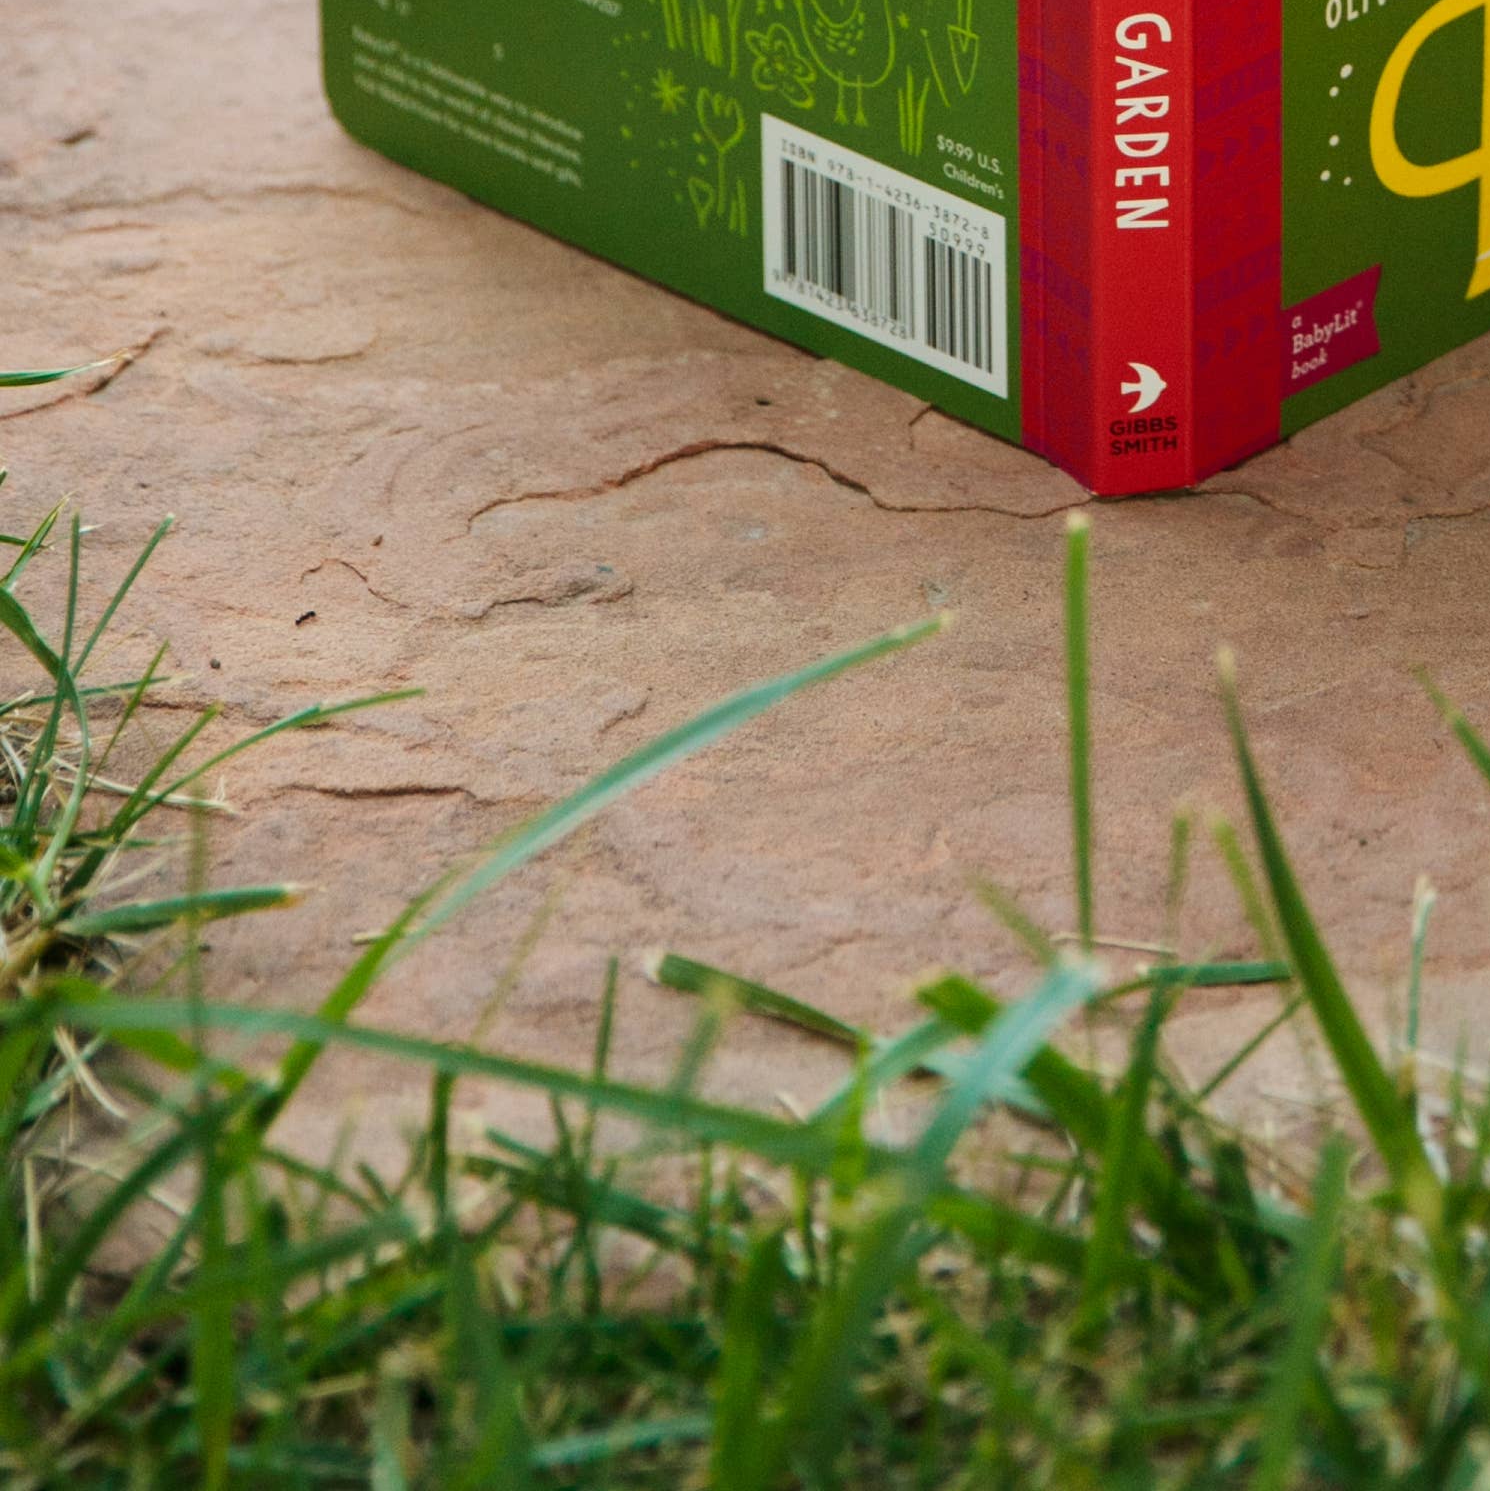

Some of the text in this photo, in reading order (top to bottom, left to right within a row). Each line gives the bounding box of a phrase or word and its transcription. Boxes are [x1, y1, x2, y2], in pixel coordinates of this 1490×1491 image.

[1114, 12, 1172, 230] GARDEN
[937, 134, 1004, 175] $9.99 U.S.
[943, 162, 1005, 199] Children's
[1291, 348, 1328, 379] book
[1110, 415, 1178, 436] GIBBS
[1110, 436, 1178, 456] SMITH
